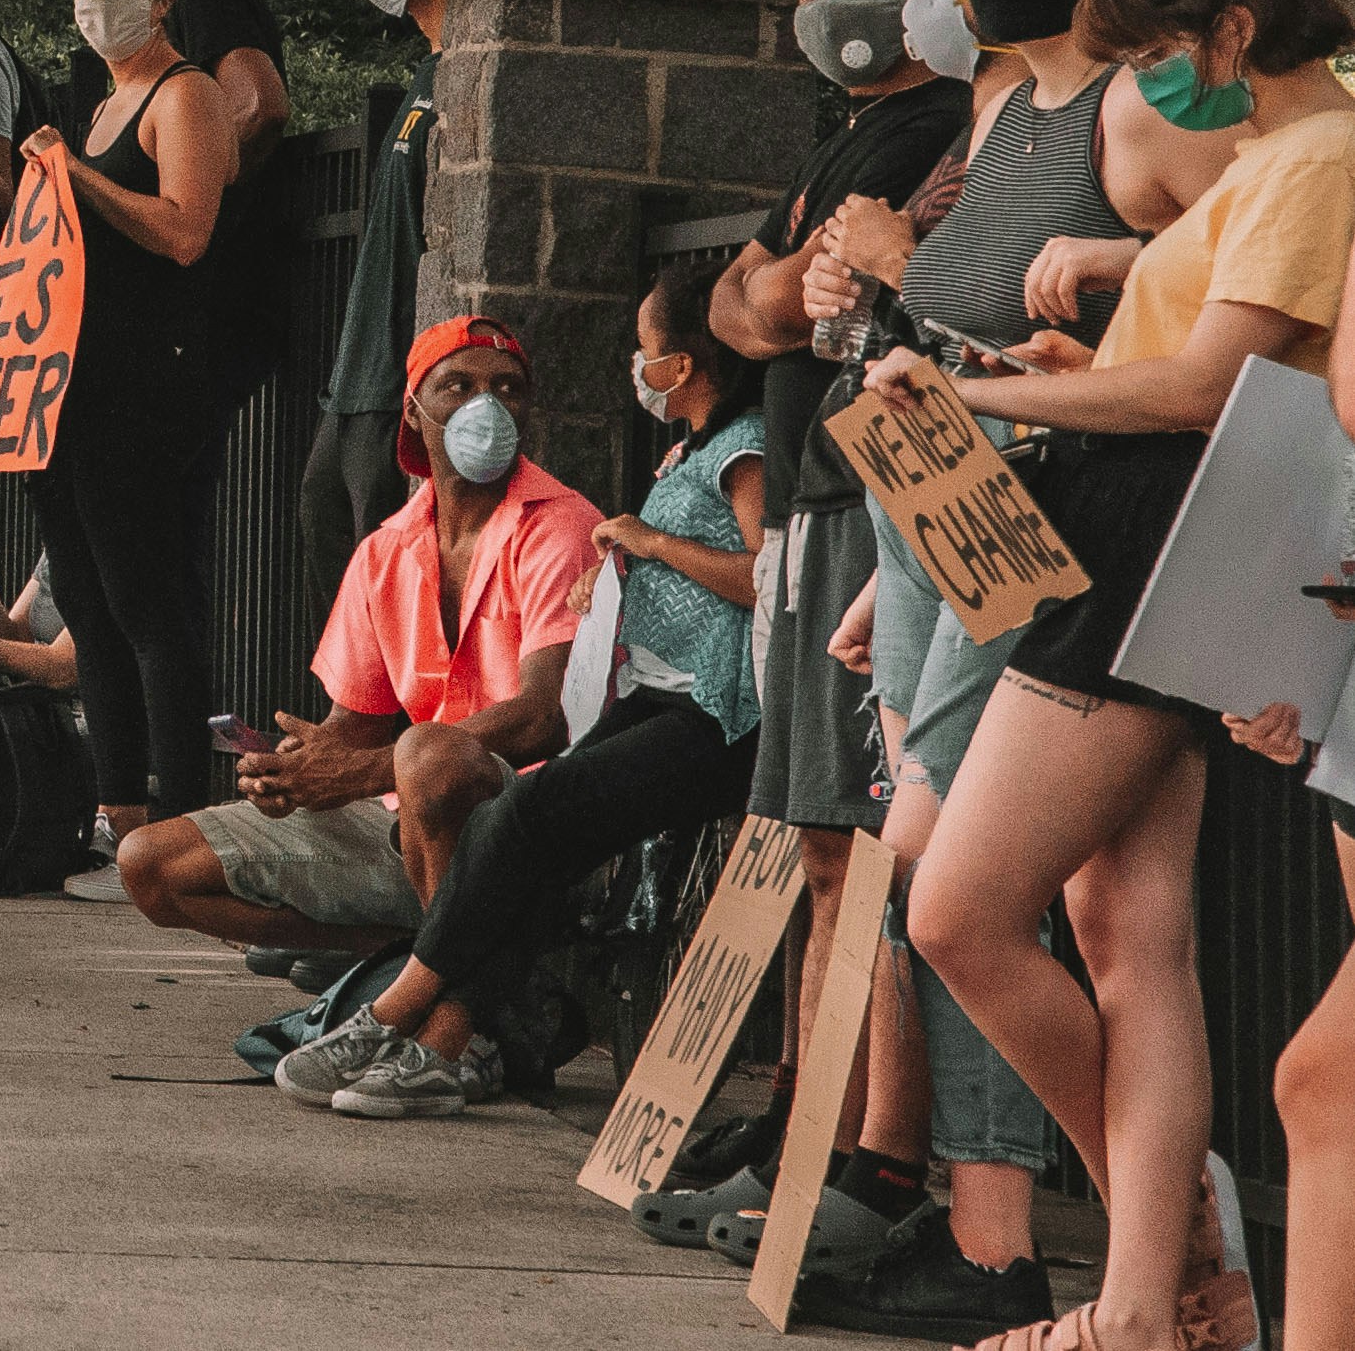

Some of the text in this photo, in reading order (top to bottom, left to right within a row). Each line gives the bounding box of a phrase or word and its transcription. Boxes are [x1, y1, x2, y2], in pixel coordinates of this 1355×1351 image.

[851, 384, 976, 495] WE NEED
[914, 471, 1070, 611] CHANGE
[731, 816, 804, 896] HOW
[645, 933, 763, 1086] MANY
[589, 1091, 685, 1192] MORE
